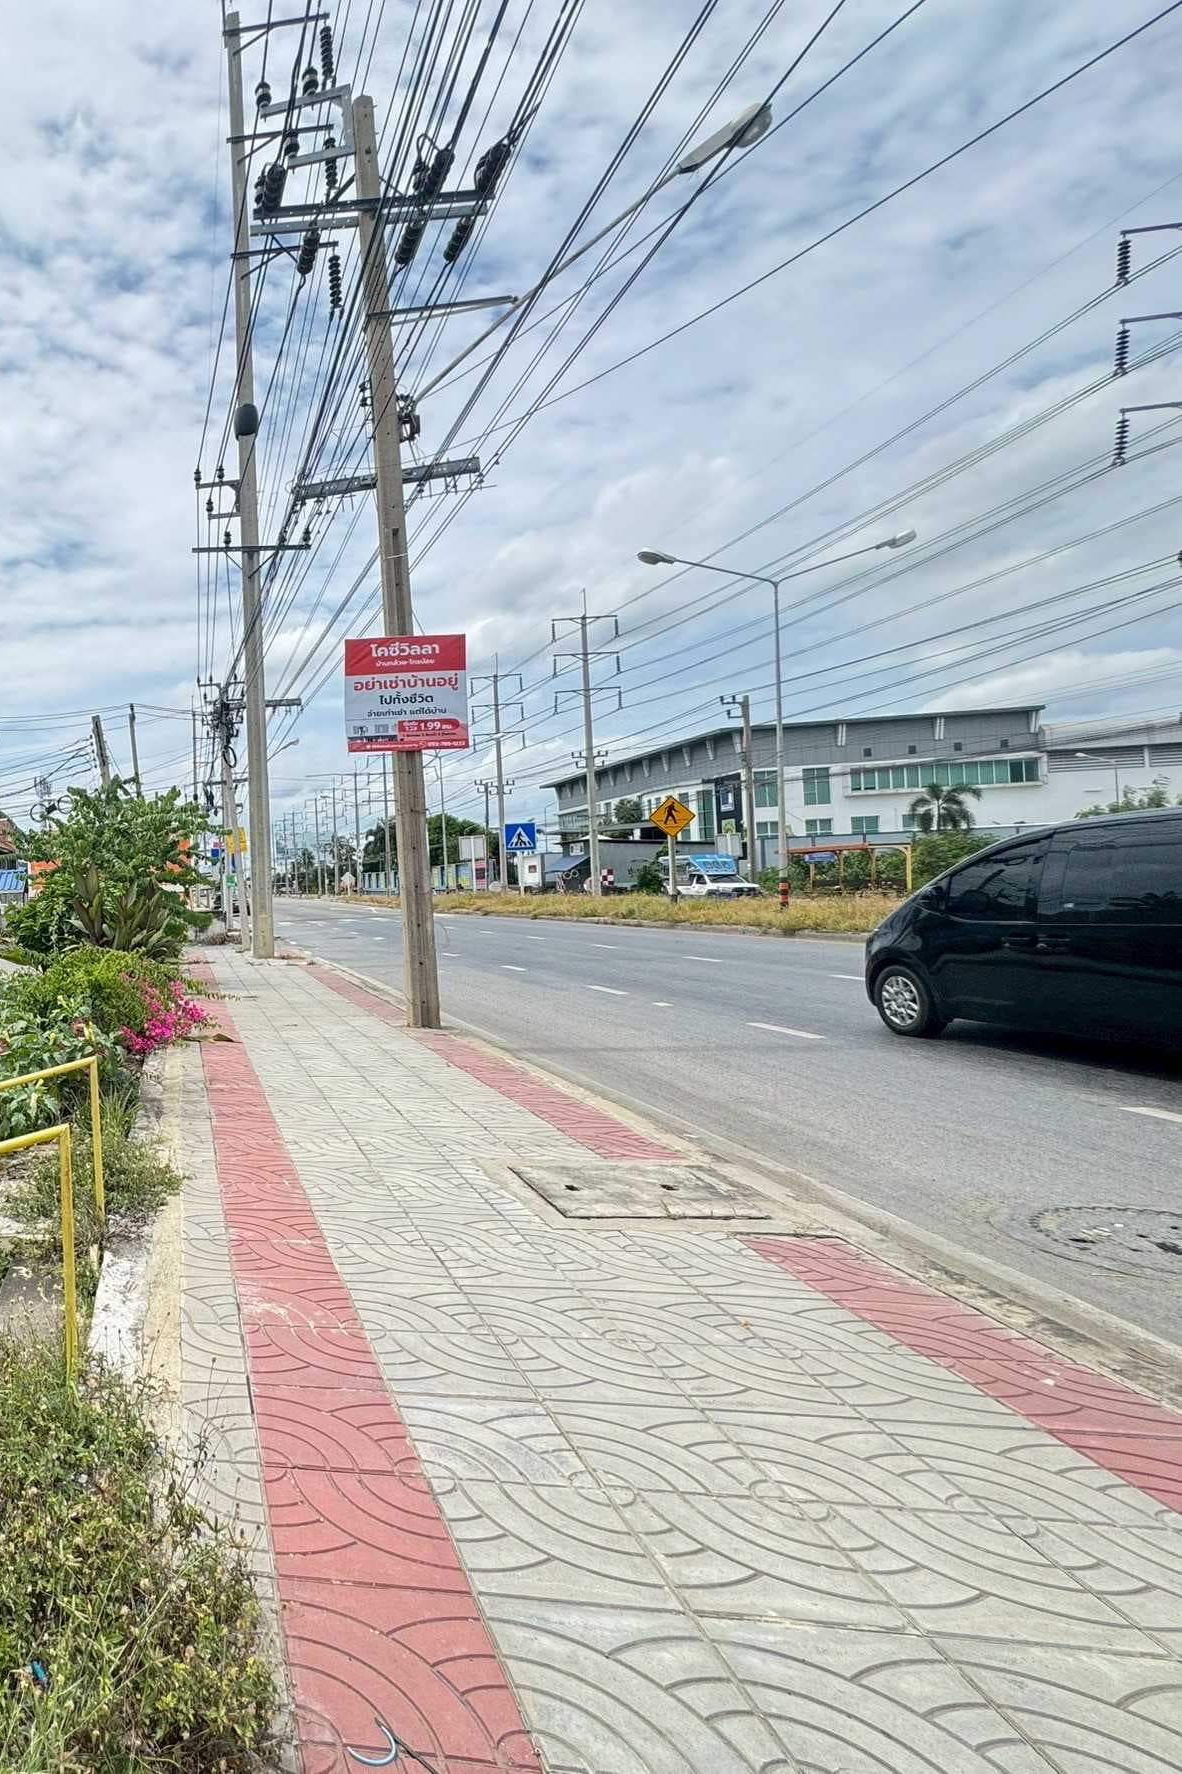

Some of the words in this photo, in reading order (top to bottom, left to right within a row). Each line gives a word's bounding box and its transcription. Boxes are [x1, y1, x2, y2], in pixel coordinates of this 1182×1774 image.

[354, 673, 459, 691] อย่าเช่าบ้านอยู่
[379, 691, 434, 705] ไปทั้งชีวิต
[420, 722, 441, 731] 1.99
